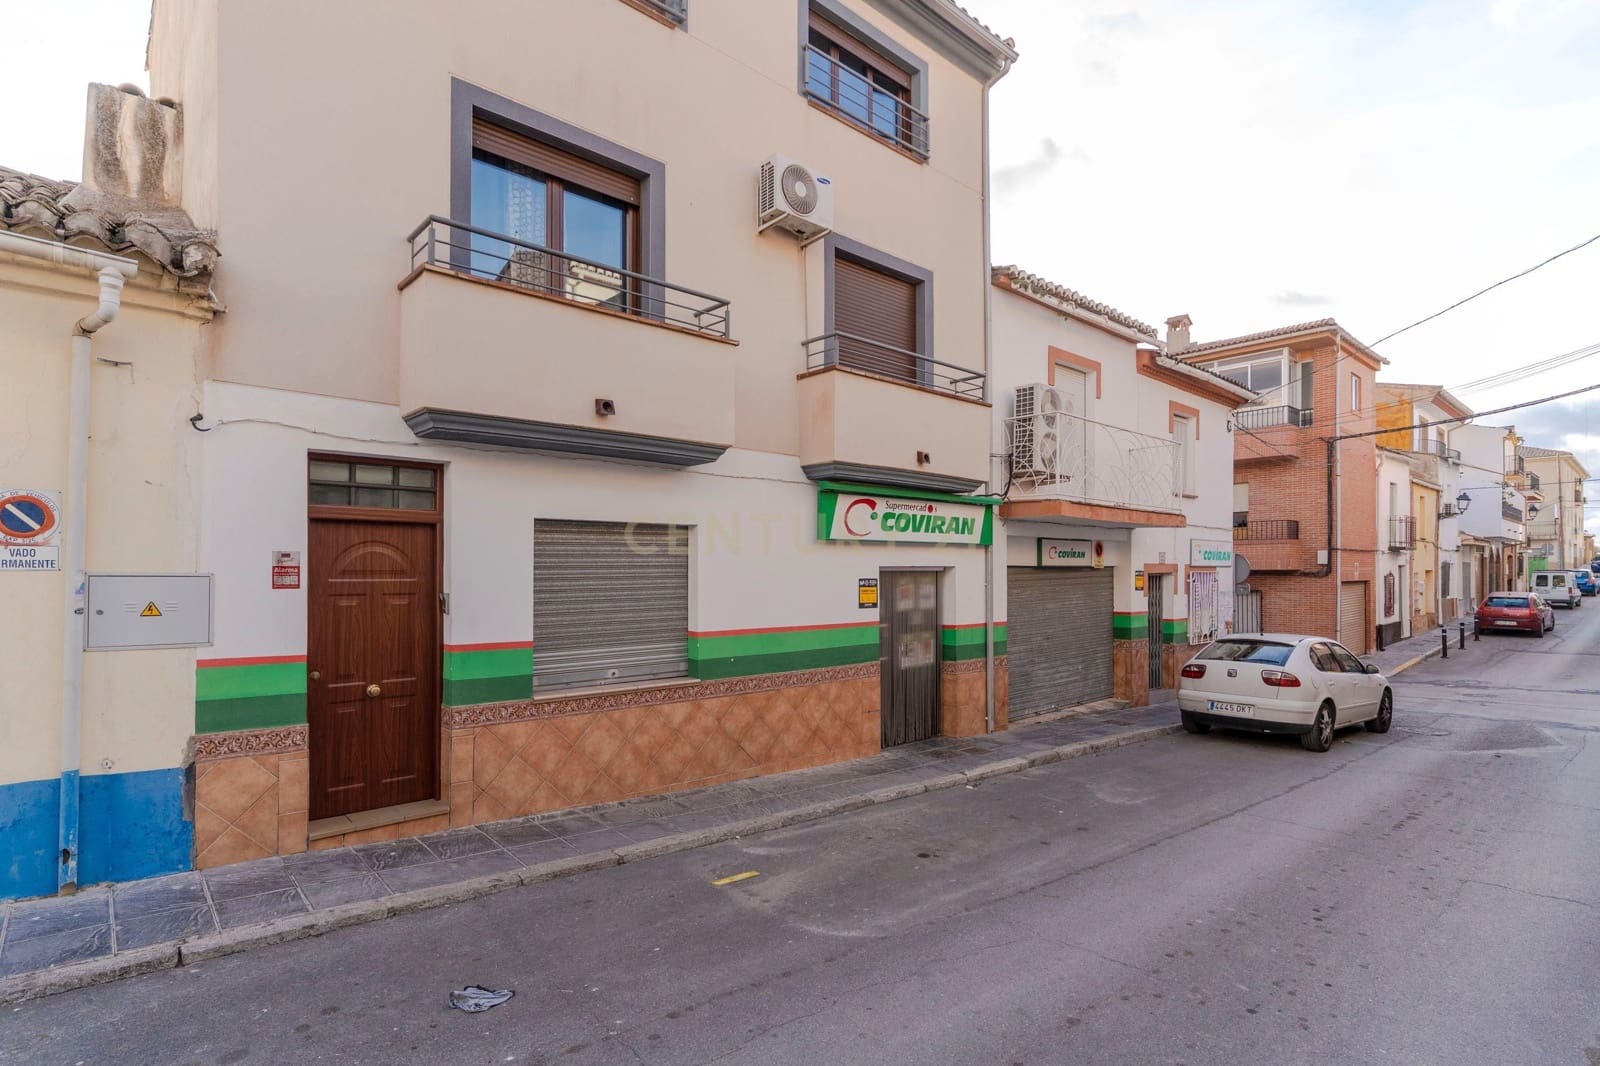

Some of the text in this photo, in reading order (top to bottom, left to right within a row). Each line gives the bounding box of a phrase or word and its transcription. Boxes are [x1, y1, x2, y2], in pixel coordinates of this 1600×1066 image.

[880, 511, 976, 535] COVIRAN
[9, 548, 36, 558] VADO
[1058, 550, 1086, 559] COVIRAN
[1203, 550, 1231, 561] COVIRAN
[1215, 703, 1252, 713] 4445 DKT
